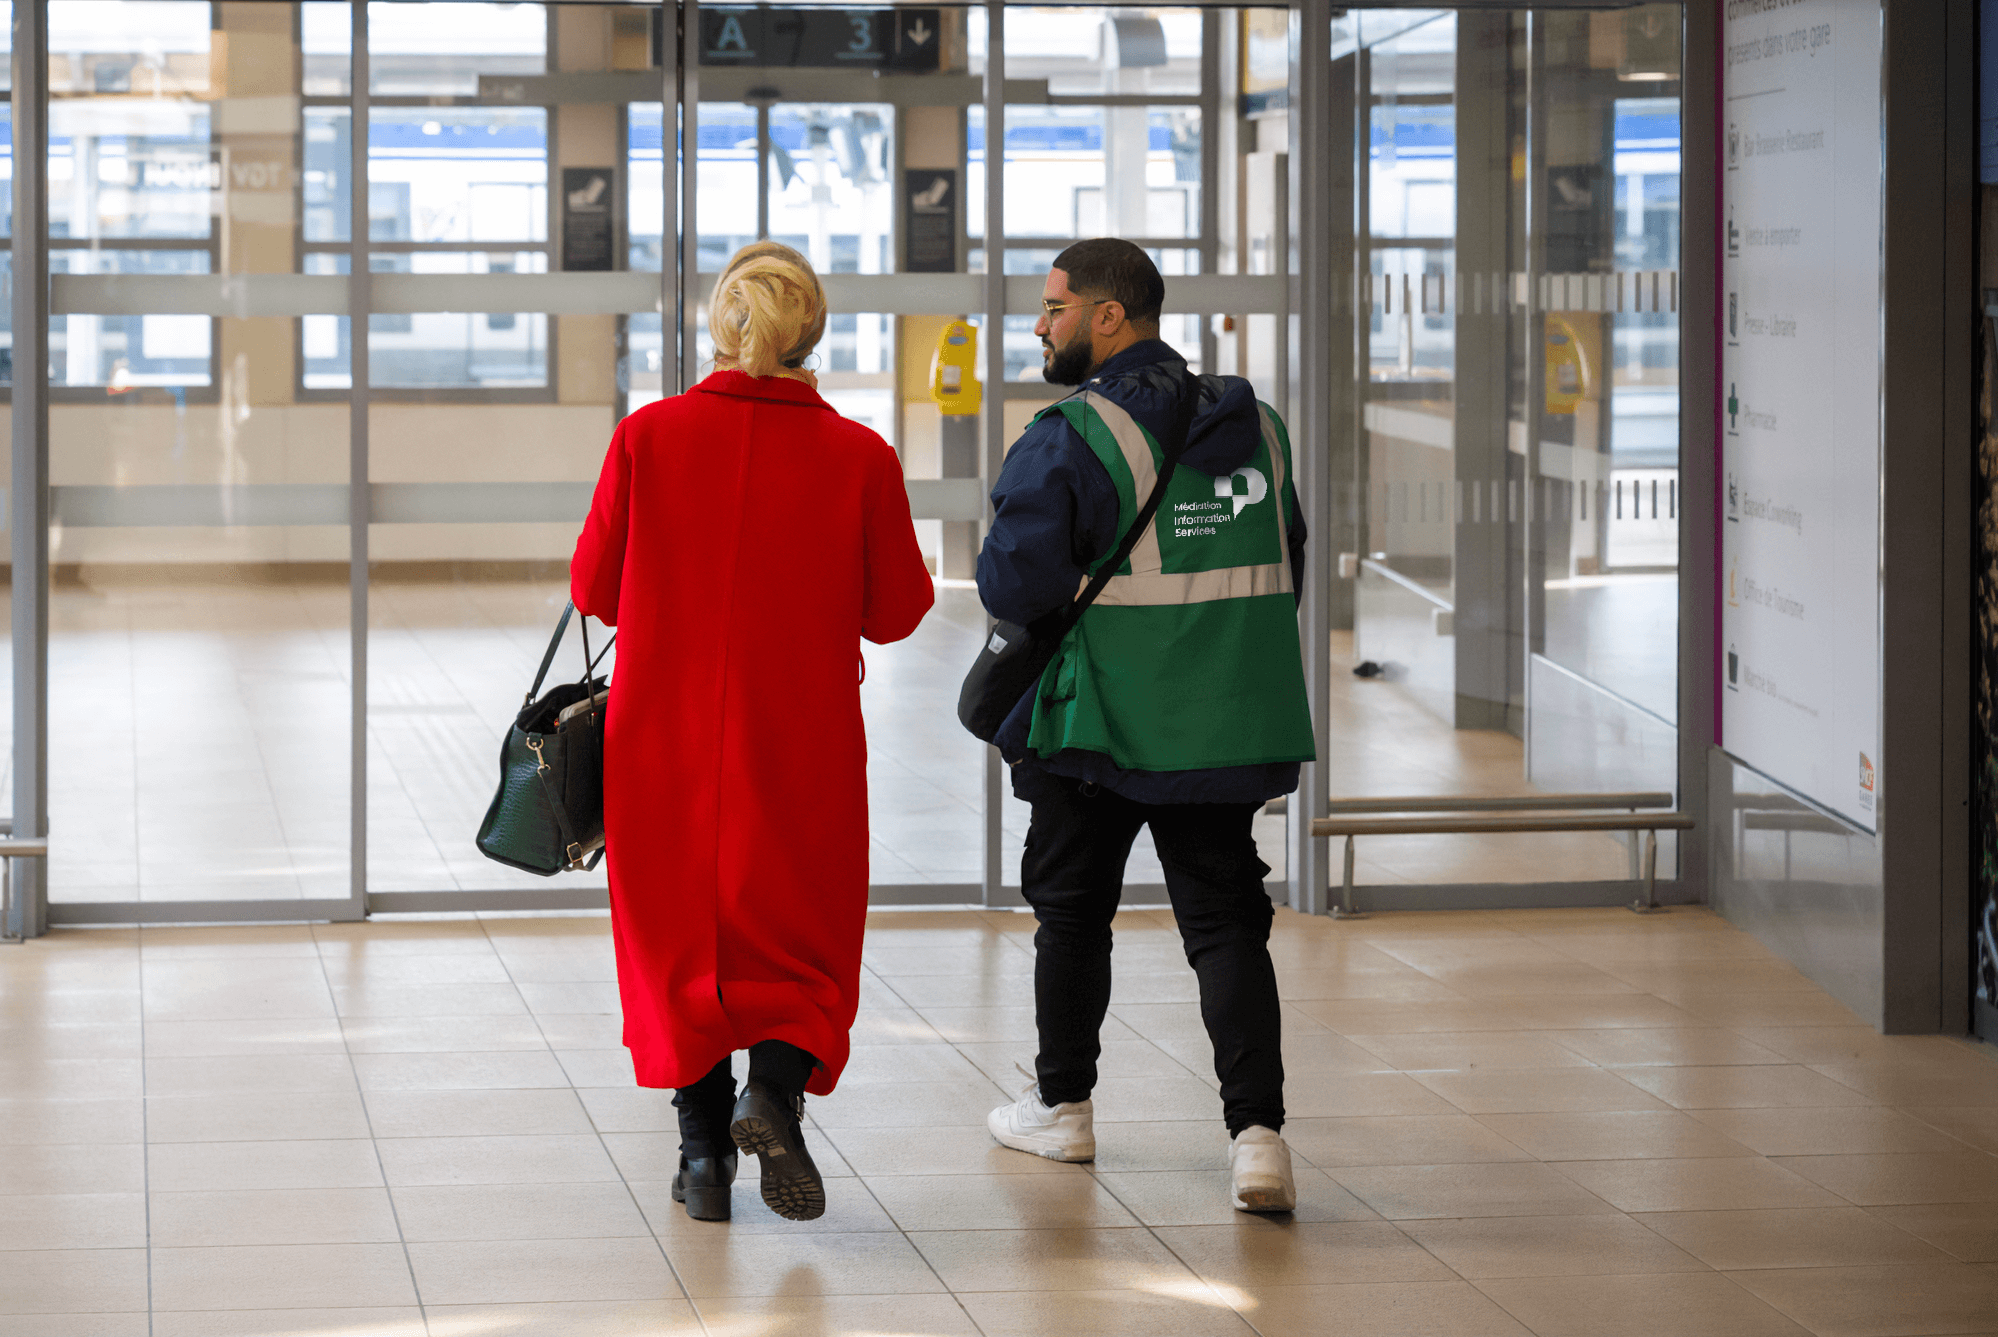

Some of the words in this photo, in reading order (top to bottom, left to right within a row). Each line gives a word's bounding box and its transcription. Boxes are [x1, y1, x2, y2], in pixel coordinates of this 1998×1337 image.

[717, 16, 747, 50] A
[849, 17, 872, 51] 3
[1784, 28, 1807, 53] votre
[1809, 22, 1831, 58] gare
[1174, 501, 1222, 513] Médiation
[1174, 513, 1231, 526] Information
[1175, 526, 1216, 538] Services
